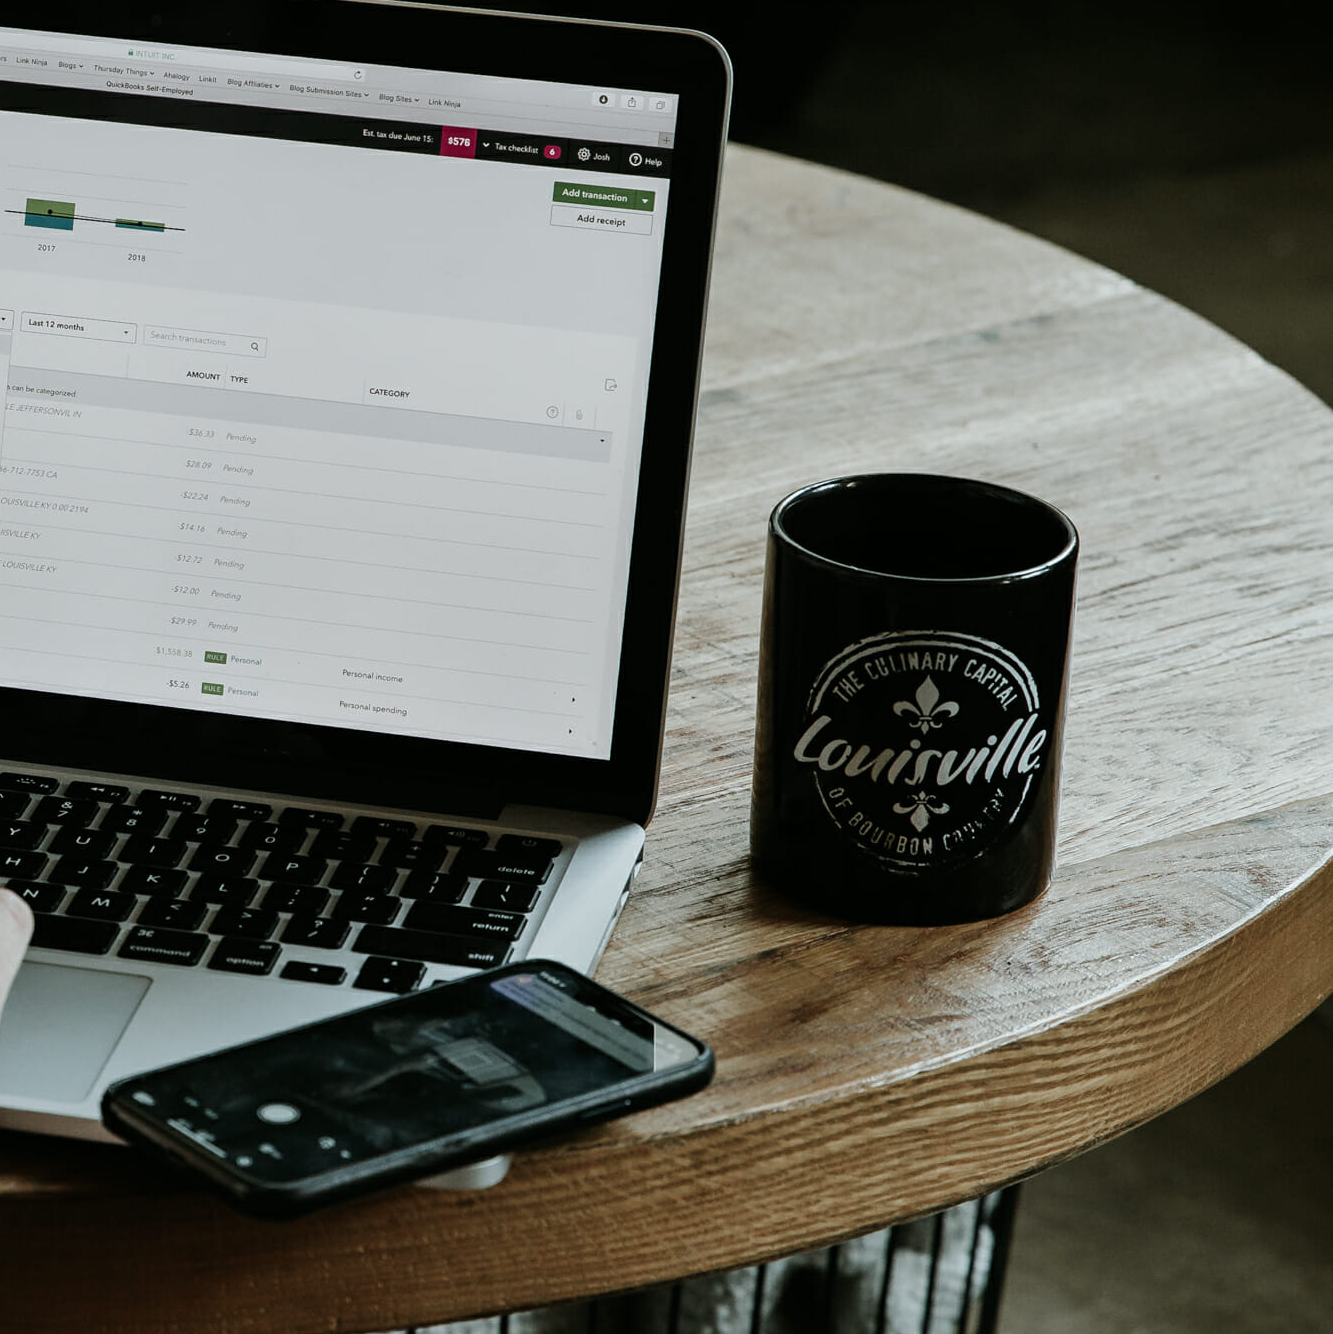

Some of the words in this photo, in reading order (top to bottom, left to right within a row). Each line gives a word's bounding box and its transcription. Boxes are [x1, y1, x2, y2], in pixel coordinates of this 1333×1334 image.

[106, 80, 144, 90] QuickBooks
[145, 84, 193, 95] Self-Employed
[362, 128, 375, 137] Est.
[388, 131, 402, 140] due
[403, 133, 421, 141] June
[423, 134, 433, 142] 15:
[495, 142, 507, 150] Tax
[507, 144, 538, 153] checklist
[593, 153, 610, 161] Josh
[644, 157, 662, 167] Help
[562, 188, 580, 197] Add
[582, 191, 627, 202] transaction
[576, 214, 595, 223] Add
[596, 218, 625, 227] receipt
[37, 243, 56, 251] 2017
[128, 253, 145, 262] 2018
[28, 318, 43, 326] Last
[56, 323, 84, 331] months
[150, 330, 177, 340] Search
[178, 335, 226, 346] transactions
[186, 371, 220, 380] AMOUNT
[230, 375, 248, 383] TYPE
[369, 387, 410, 398] CATEGORY
[342, 668, 374, 679] Personal
[375, 675, 402, 683] income
[833, 670, 865, 703] THE
[864, 651, 959, 681] CULINARY
[963, 658, 1019, 712] CAPITAL
[166, 679, 189, 688] -$5.26
[339, 700, 370, 711] Personal
[372, 706, 407, 717] spending
[793, 712, 1048, 787] Louisville
[828, 787, 854, 810] OF
[848, 811, 933, 856] BOURBON
[497, 865, 536, 876] delete
[472, 921, 509, 933] return
[467, 952, 495, 963] shift
